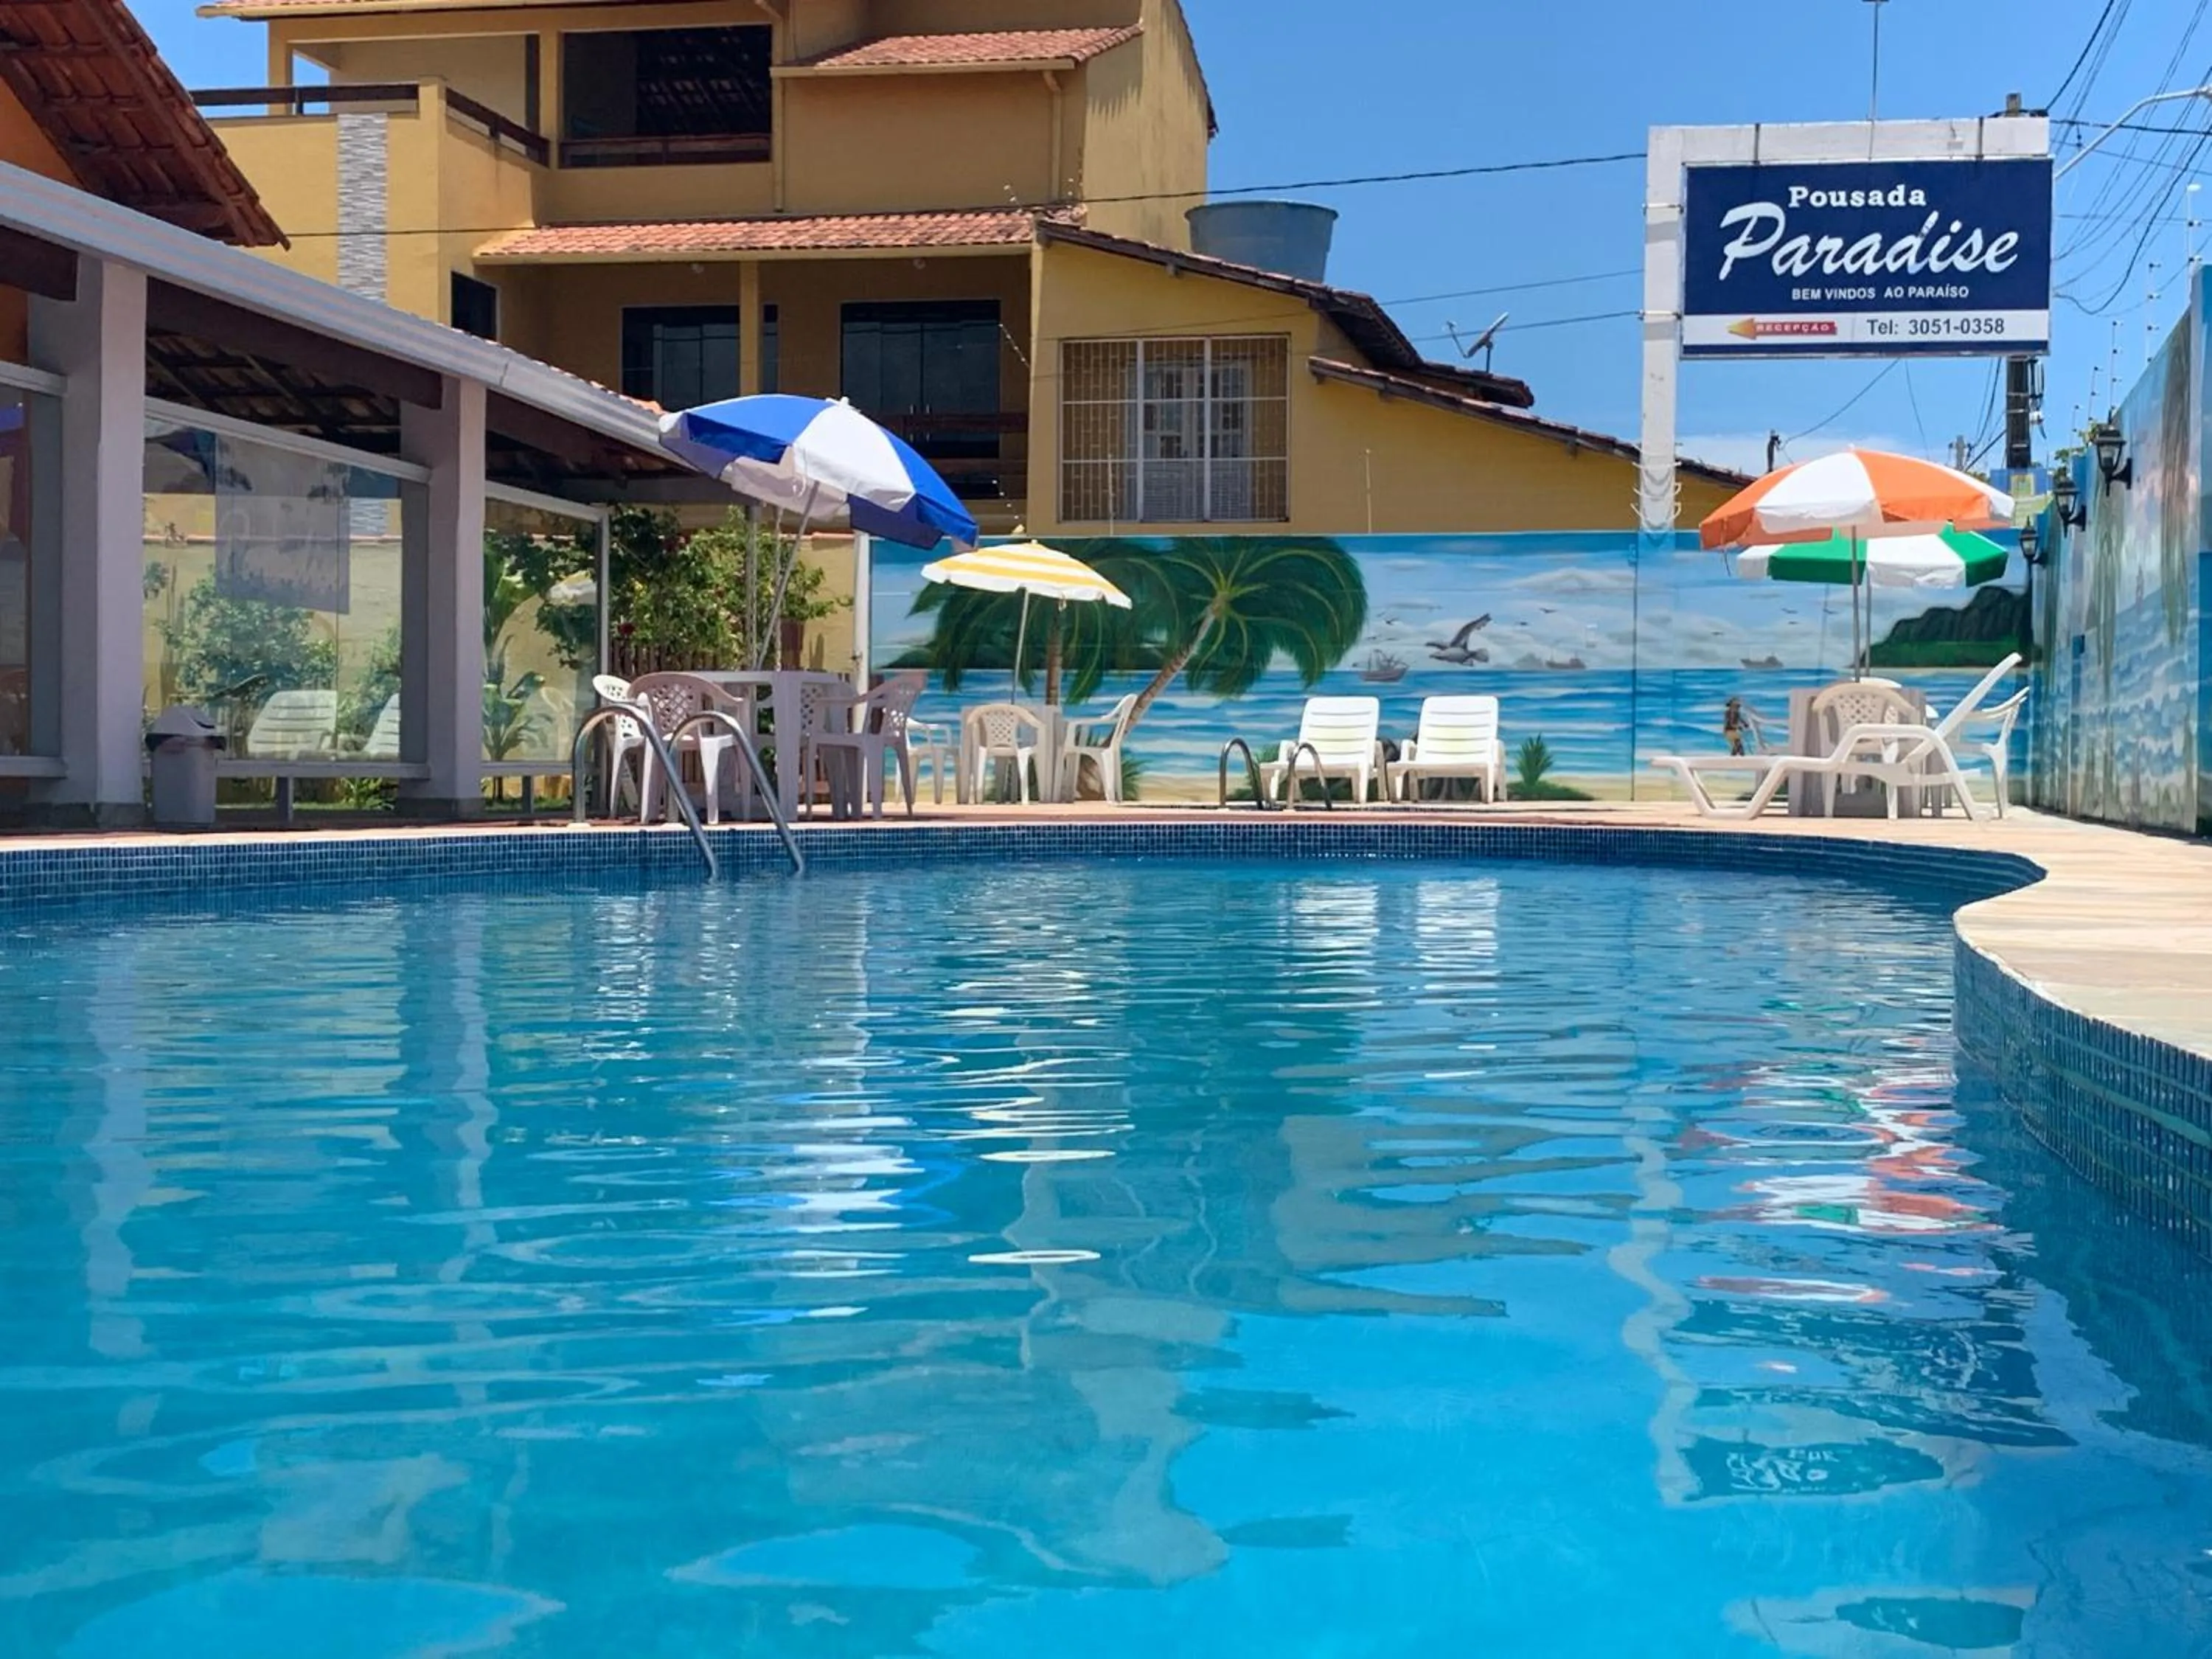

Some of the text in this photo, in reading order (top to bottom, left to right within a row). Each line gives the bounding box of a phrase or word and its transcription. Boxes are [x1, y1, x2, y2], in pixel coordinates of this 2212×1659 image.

[1788, 184, 1927, 208] Pousada
[1719, 201, 2019, 281] Paradise
[1791, 283, 1969, 300] BEM VINDOS AO PARAÍSO
[1866, 318, 2005, 335] Tel: 3051-0358
